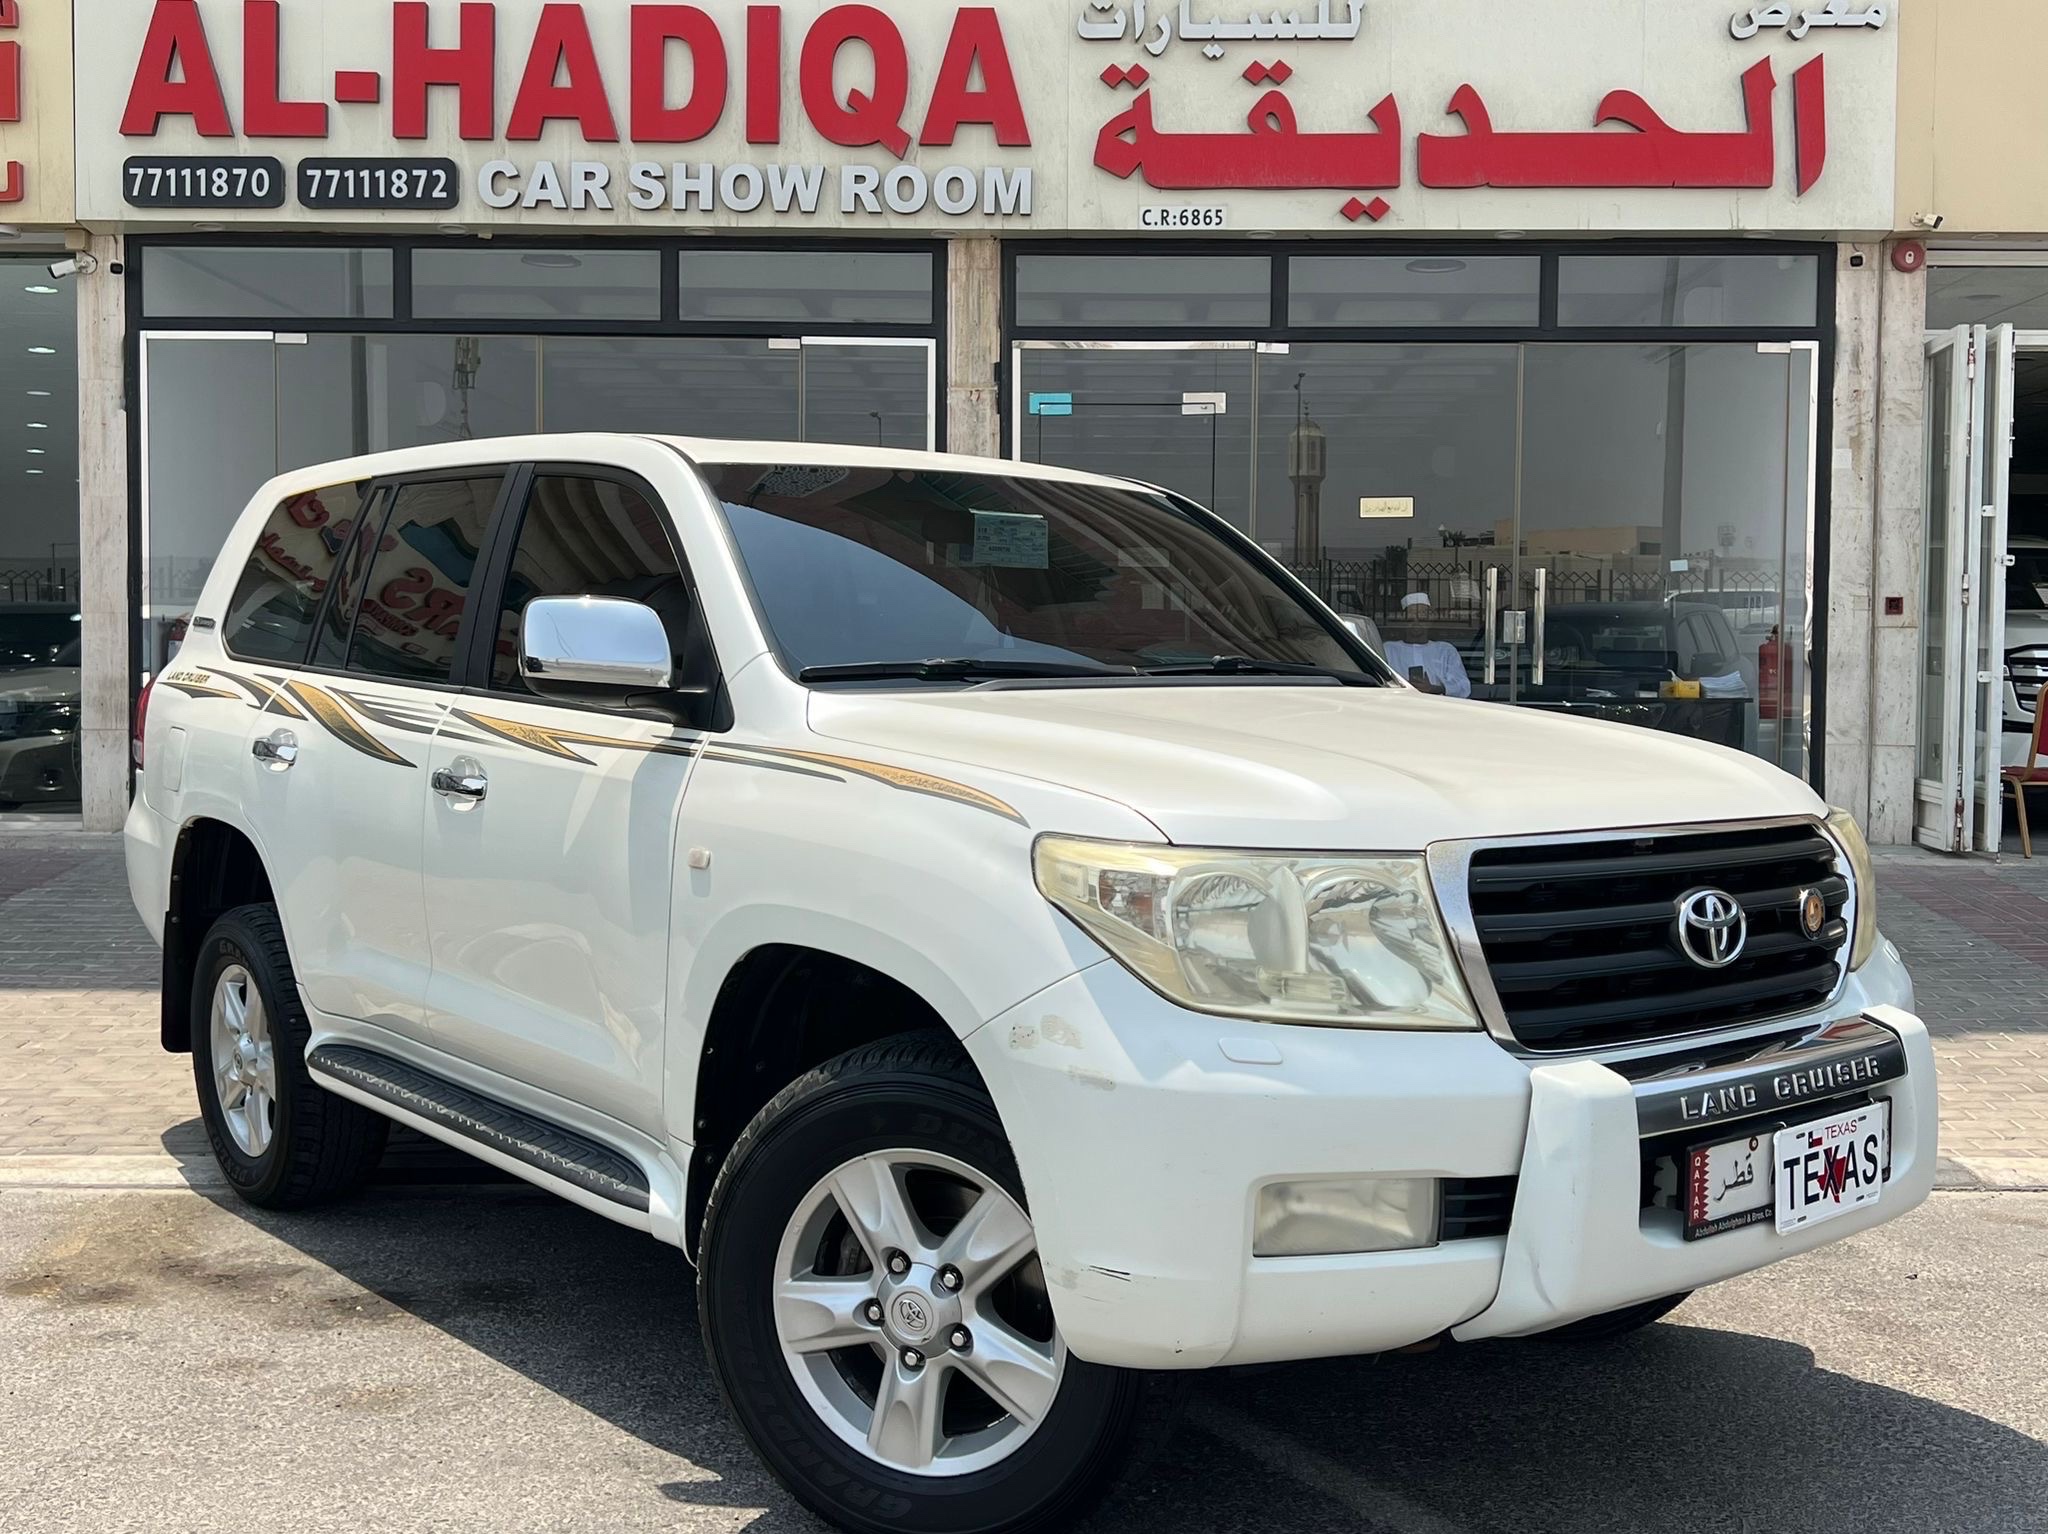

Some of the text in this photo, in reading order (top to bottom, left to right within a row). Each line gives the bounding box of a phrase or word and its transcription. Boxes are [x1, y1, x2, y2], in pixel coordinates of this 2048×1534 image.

[1077, 0, 1887, 59] معرض للسيارات
[119, 0, 1032, 160] AL-HADIQA
[1093, 53, 1826, 221] الحديقة
[128, 167, 448, 199] 77111870 77111872
[477, 160, 1033, 215] CAR SHOW ROOM
[1142, 208, 1223, 226] C.R:6865
[1680, 1055, 1880, 1120] LAND CRUISER
[1825, 1120, 1858, 1140] TEXAS
[1693, 1156, 1702, 1219] QATAR
[1713, 1152, 1754, 1202] قطر
[1783, 1134, 1878, 1210] TEXAS
